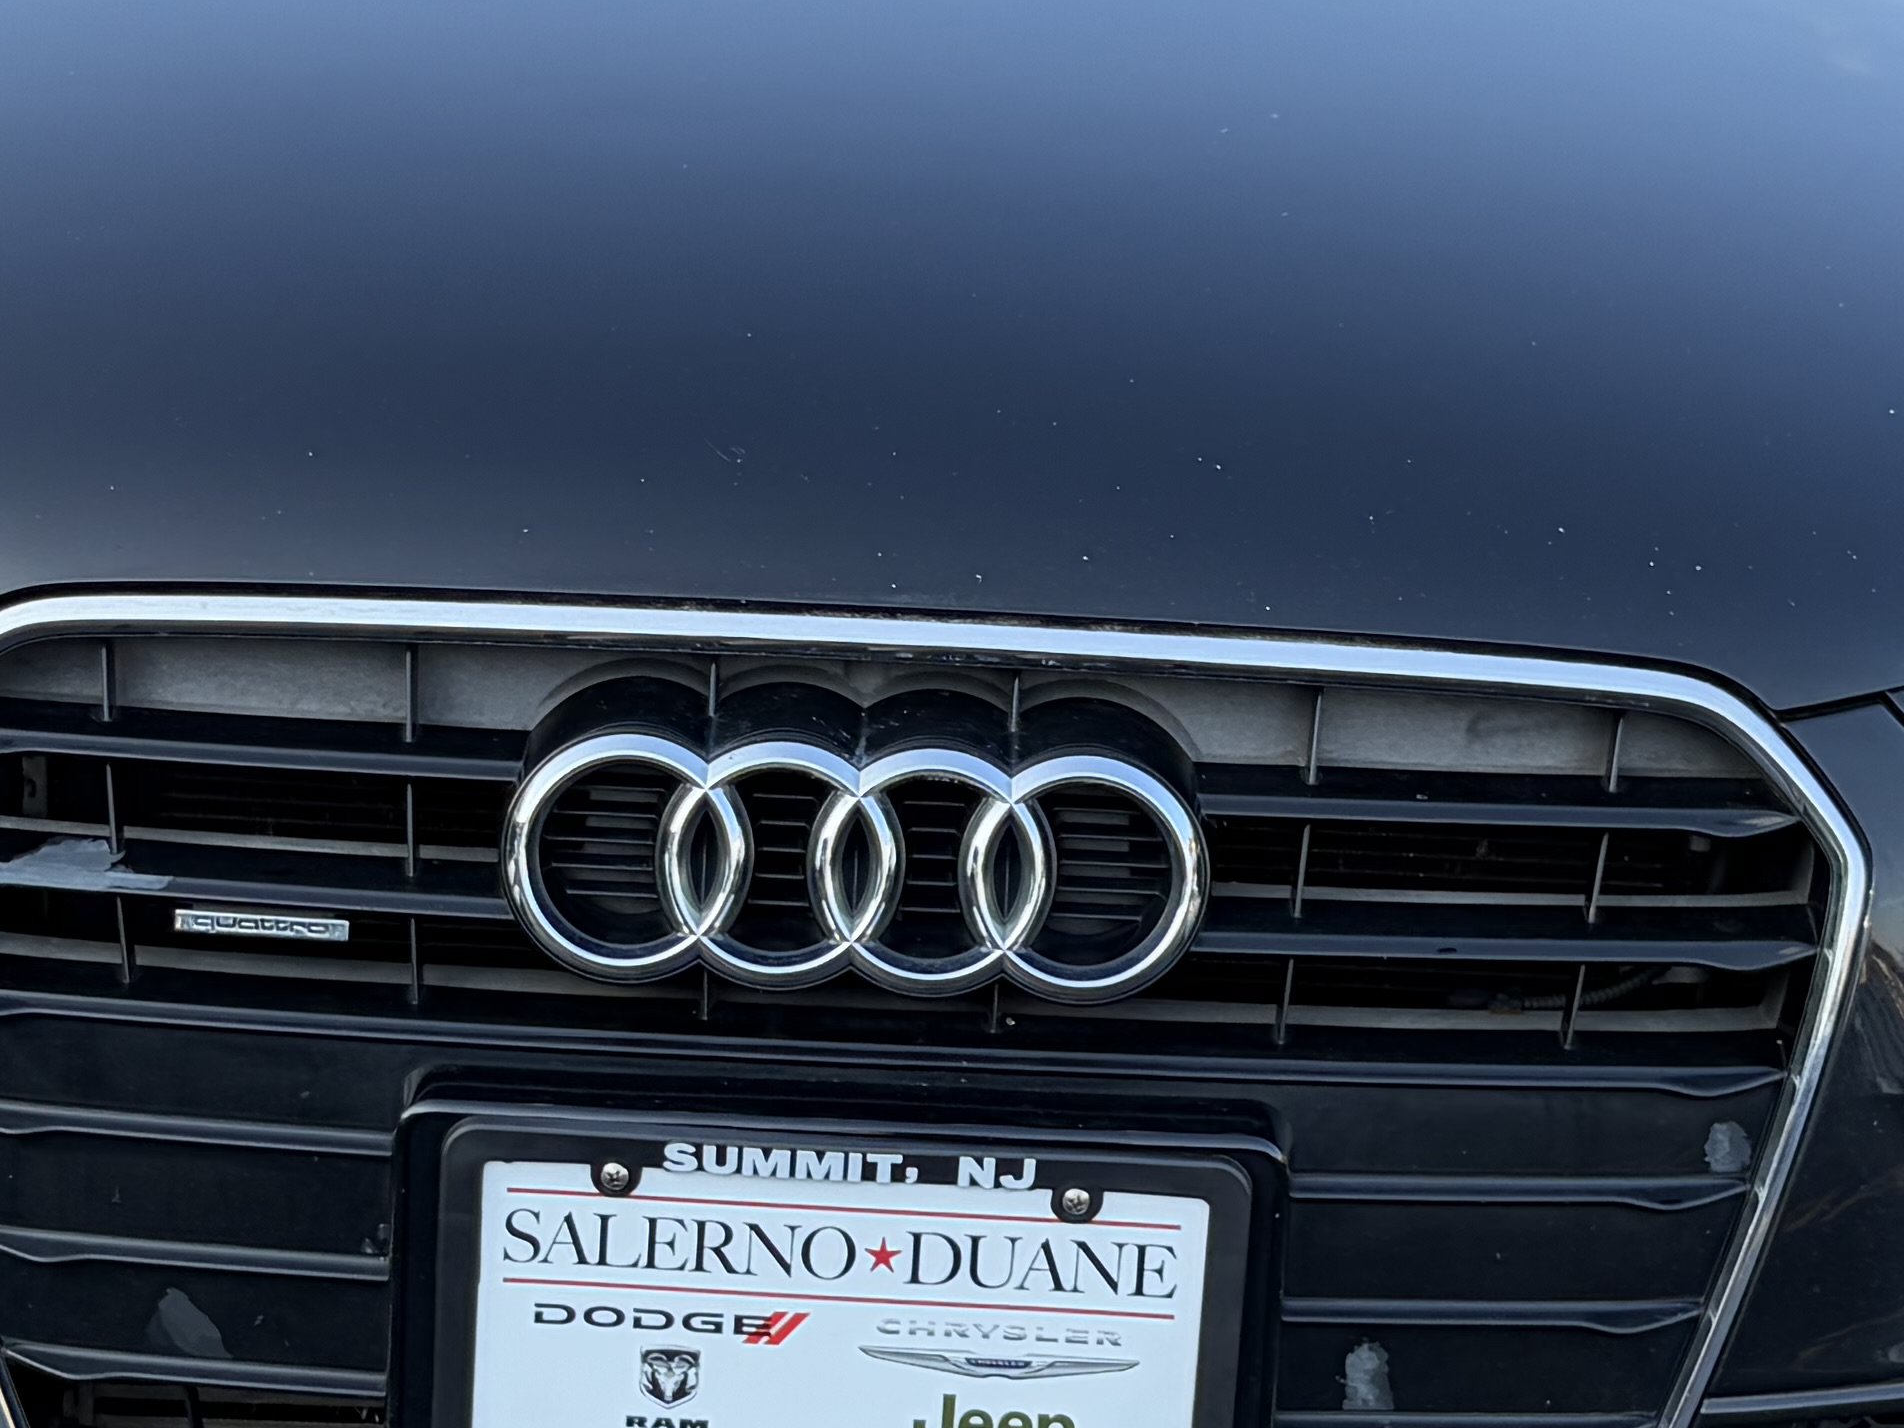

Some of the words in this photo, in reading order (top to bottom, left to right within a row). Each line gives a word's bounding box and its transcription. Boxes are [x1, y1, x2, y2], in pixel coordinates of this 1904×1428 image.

[195, 916, 329, 935] quattro
[663, 1142, 919, 1184] SUMMIT,
[957, 1156, 1037, 1190] NJ
[503, 1208, 856, 1280] SALERNO
[903, 1230, 1177, 1300] DUANE
[534, 1302, 773, 1336] DODGE
[876, 1318, 1122, 1347] CHRYSLER
